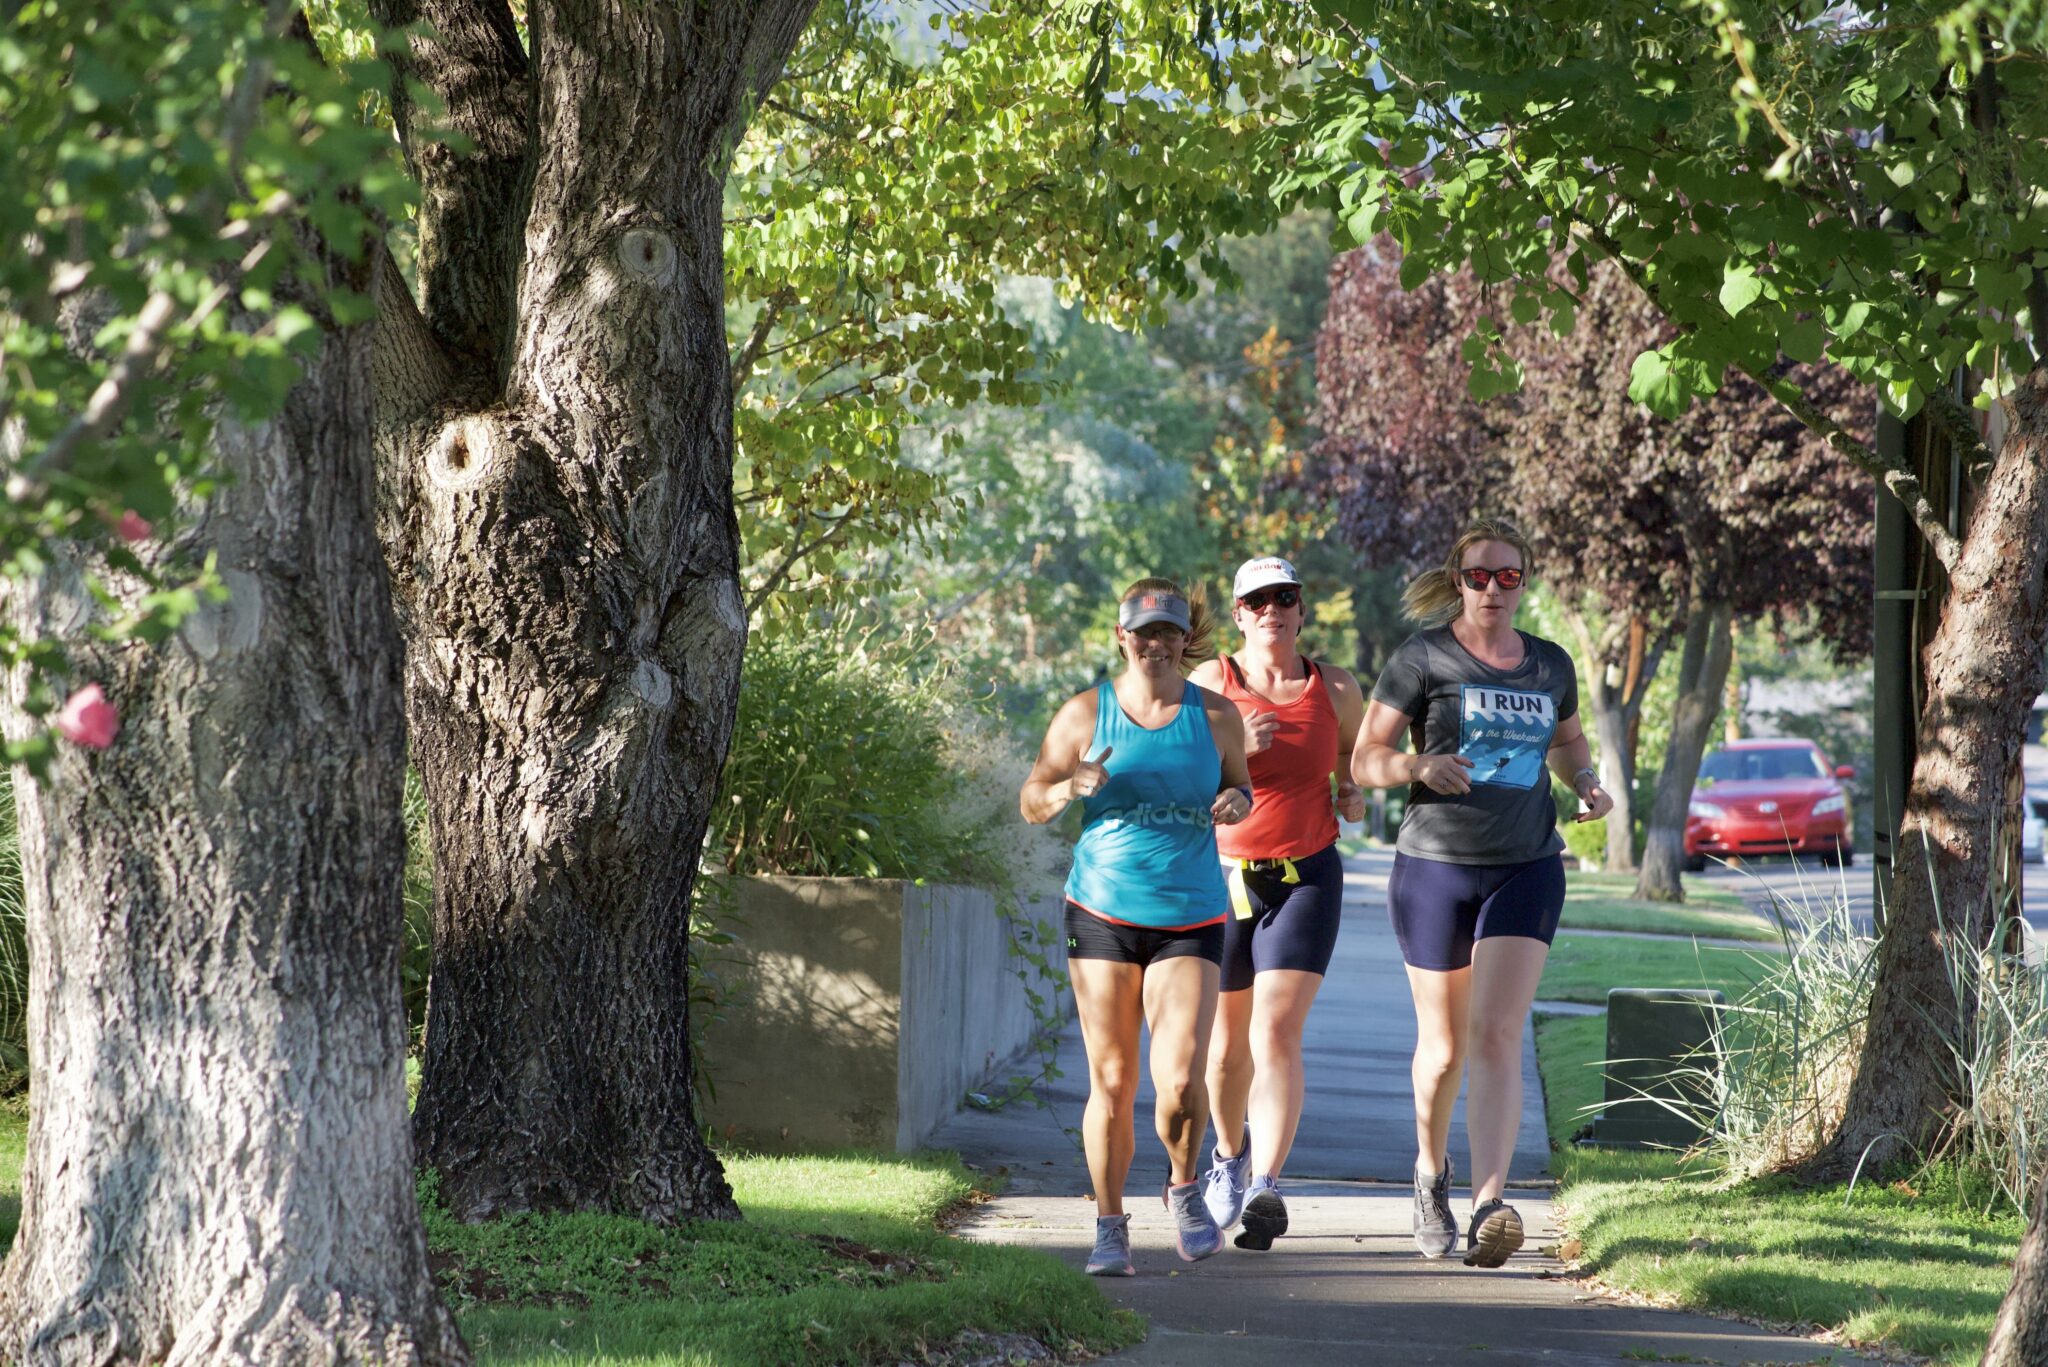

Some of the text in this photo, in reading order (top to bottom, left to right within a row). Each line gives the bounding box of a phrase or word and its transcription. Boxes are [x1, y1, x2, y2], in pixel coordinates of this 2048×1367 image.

[1480, 691, 1543, 713] I RUN
[1486, 728, 1500, 738] the
[1102, 802, 1209, 828] adidas
